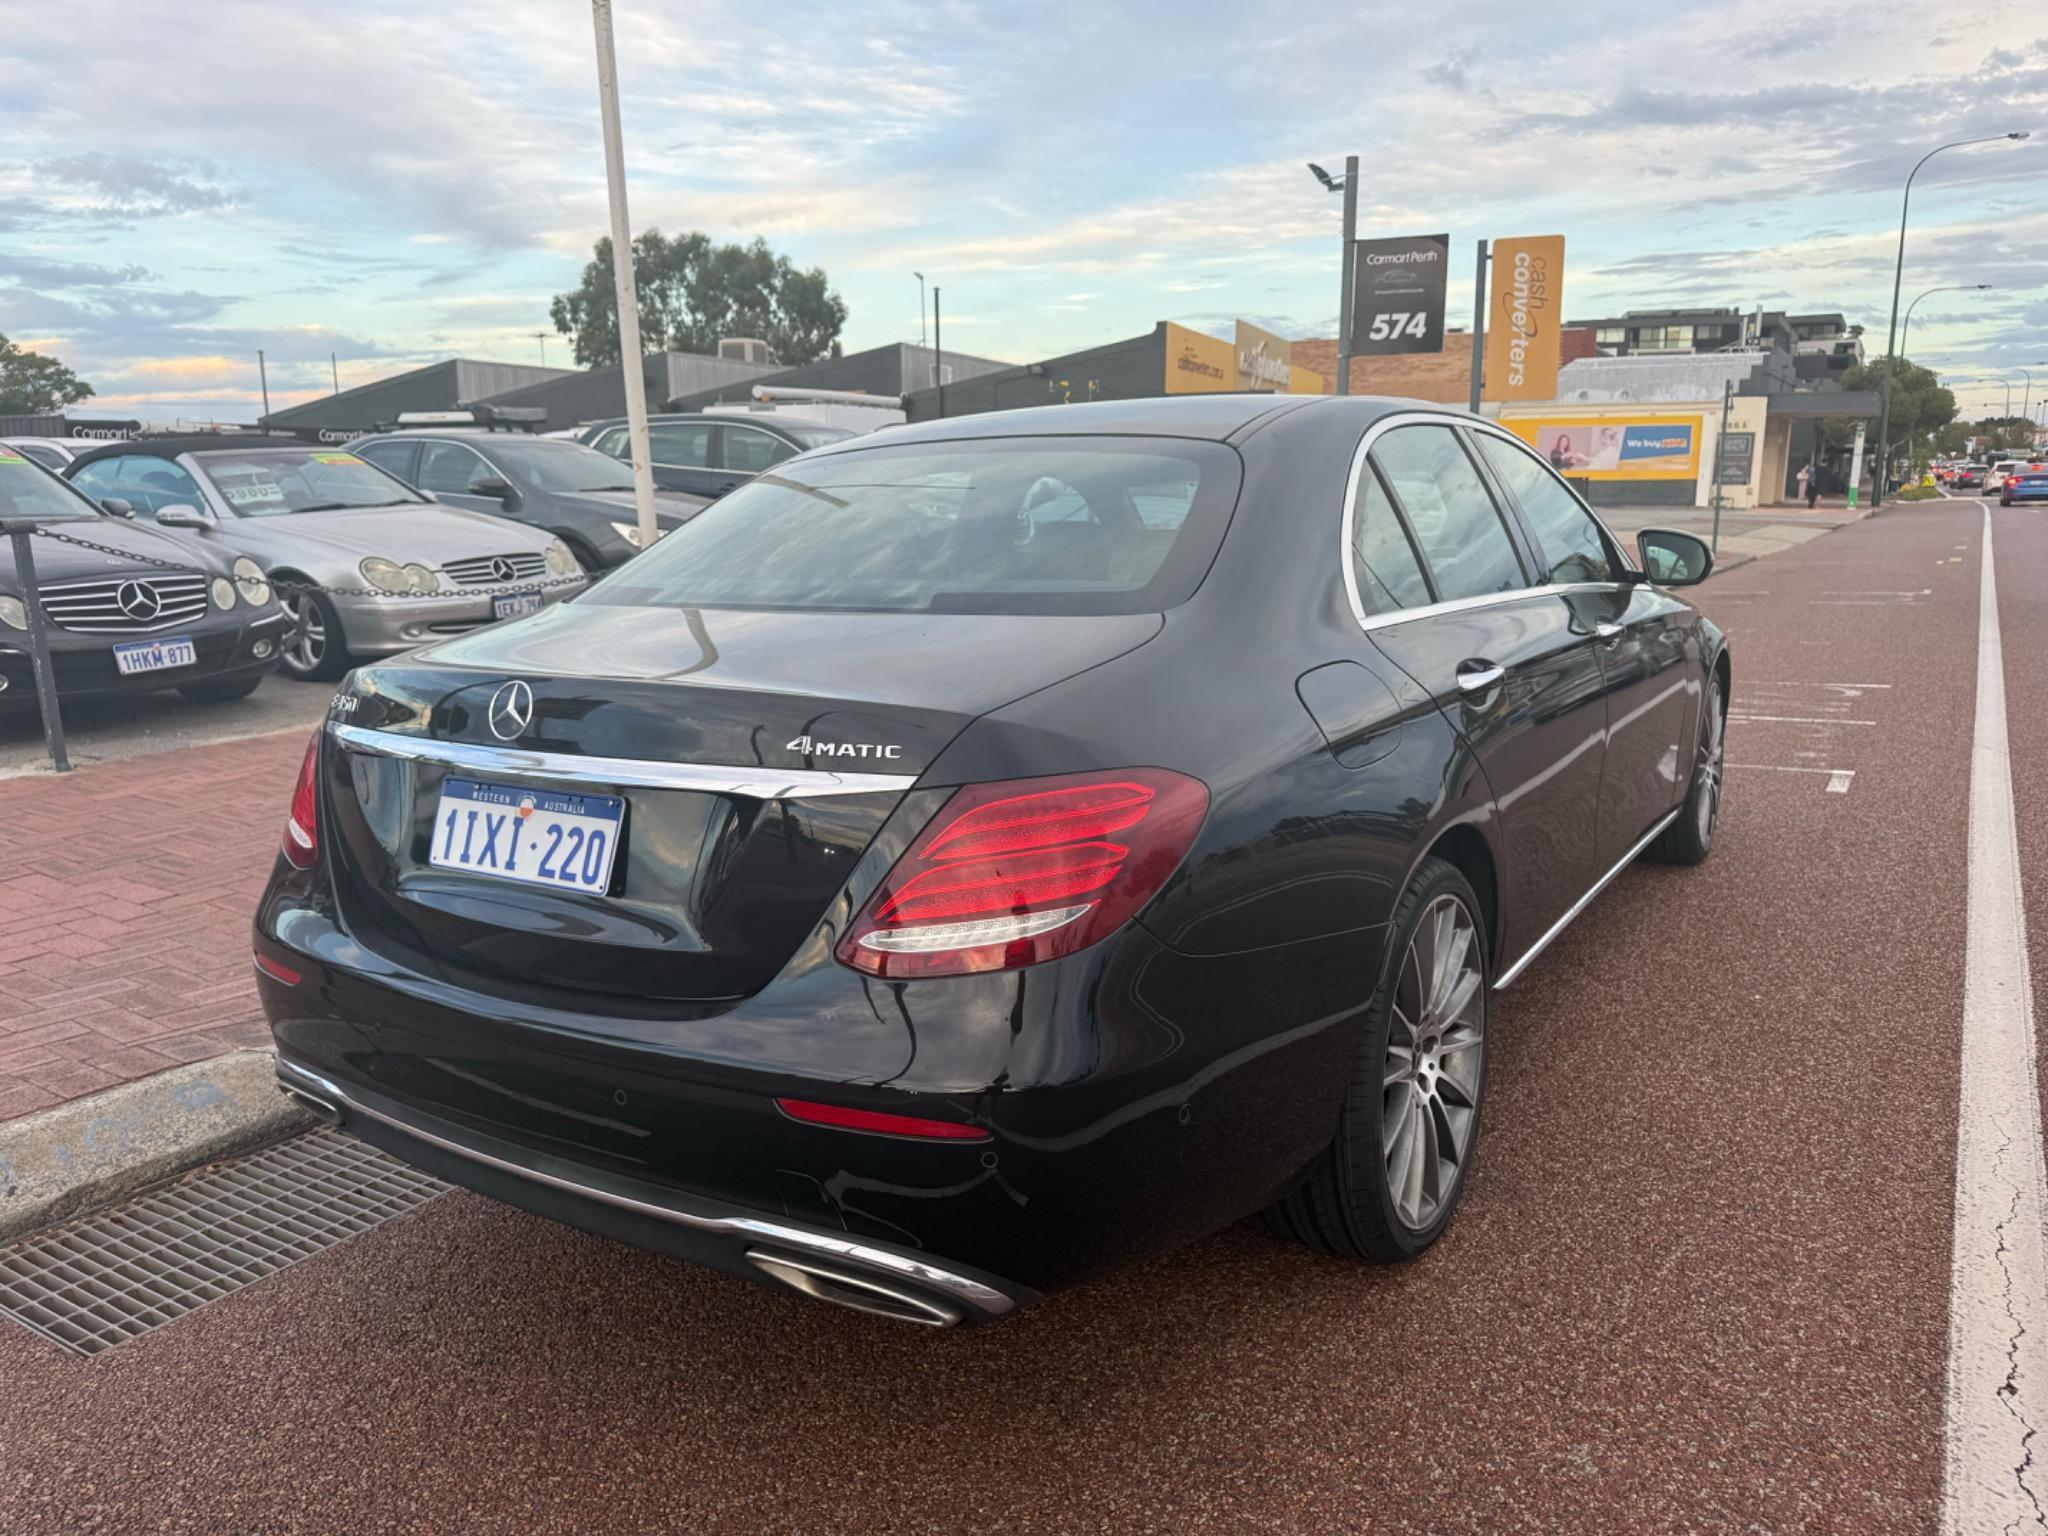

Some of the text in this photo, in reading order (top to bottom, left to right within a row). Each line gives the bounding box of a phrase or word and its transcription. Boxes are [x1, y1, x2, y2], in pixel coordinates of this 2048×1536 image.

[1366, 250, 1438, 266] Carmart Perth
[1531, 257, 1548, 309] cash
[1369, 312, 1427, 341] 574
[1508, 252, 1530, 387] converters
[72, 426, 127, 440] Carmart
[319, 428, 358, 442] Carmart
[1627, 439, 1641, 447] We
[1643, 438, 1660, 449] buy
[785, 735, 903, 760] 4MATIC
[472, 791, 585, 815] WESTERN AUSTRALIA
